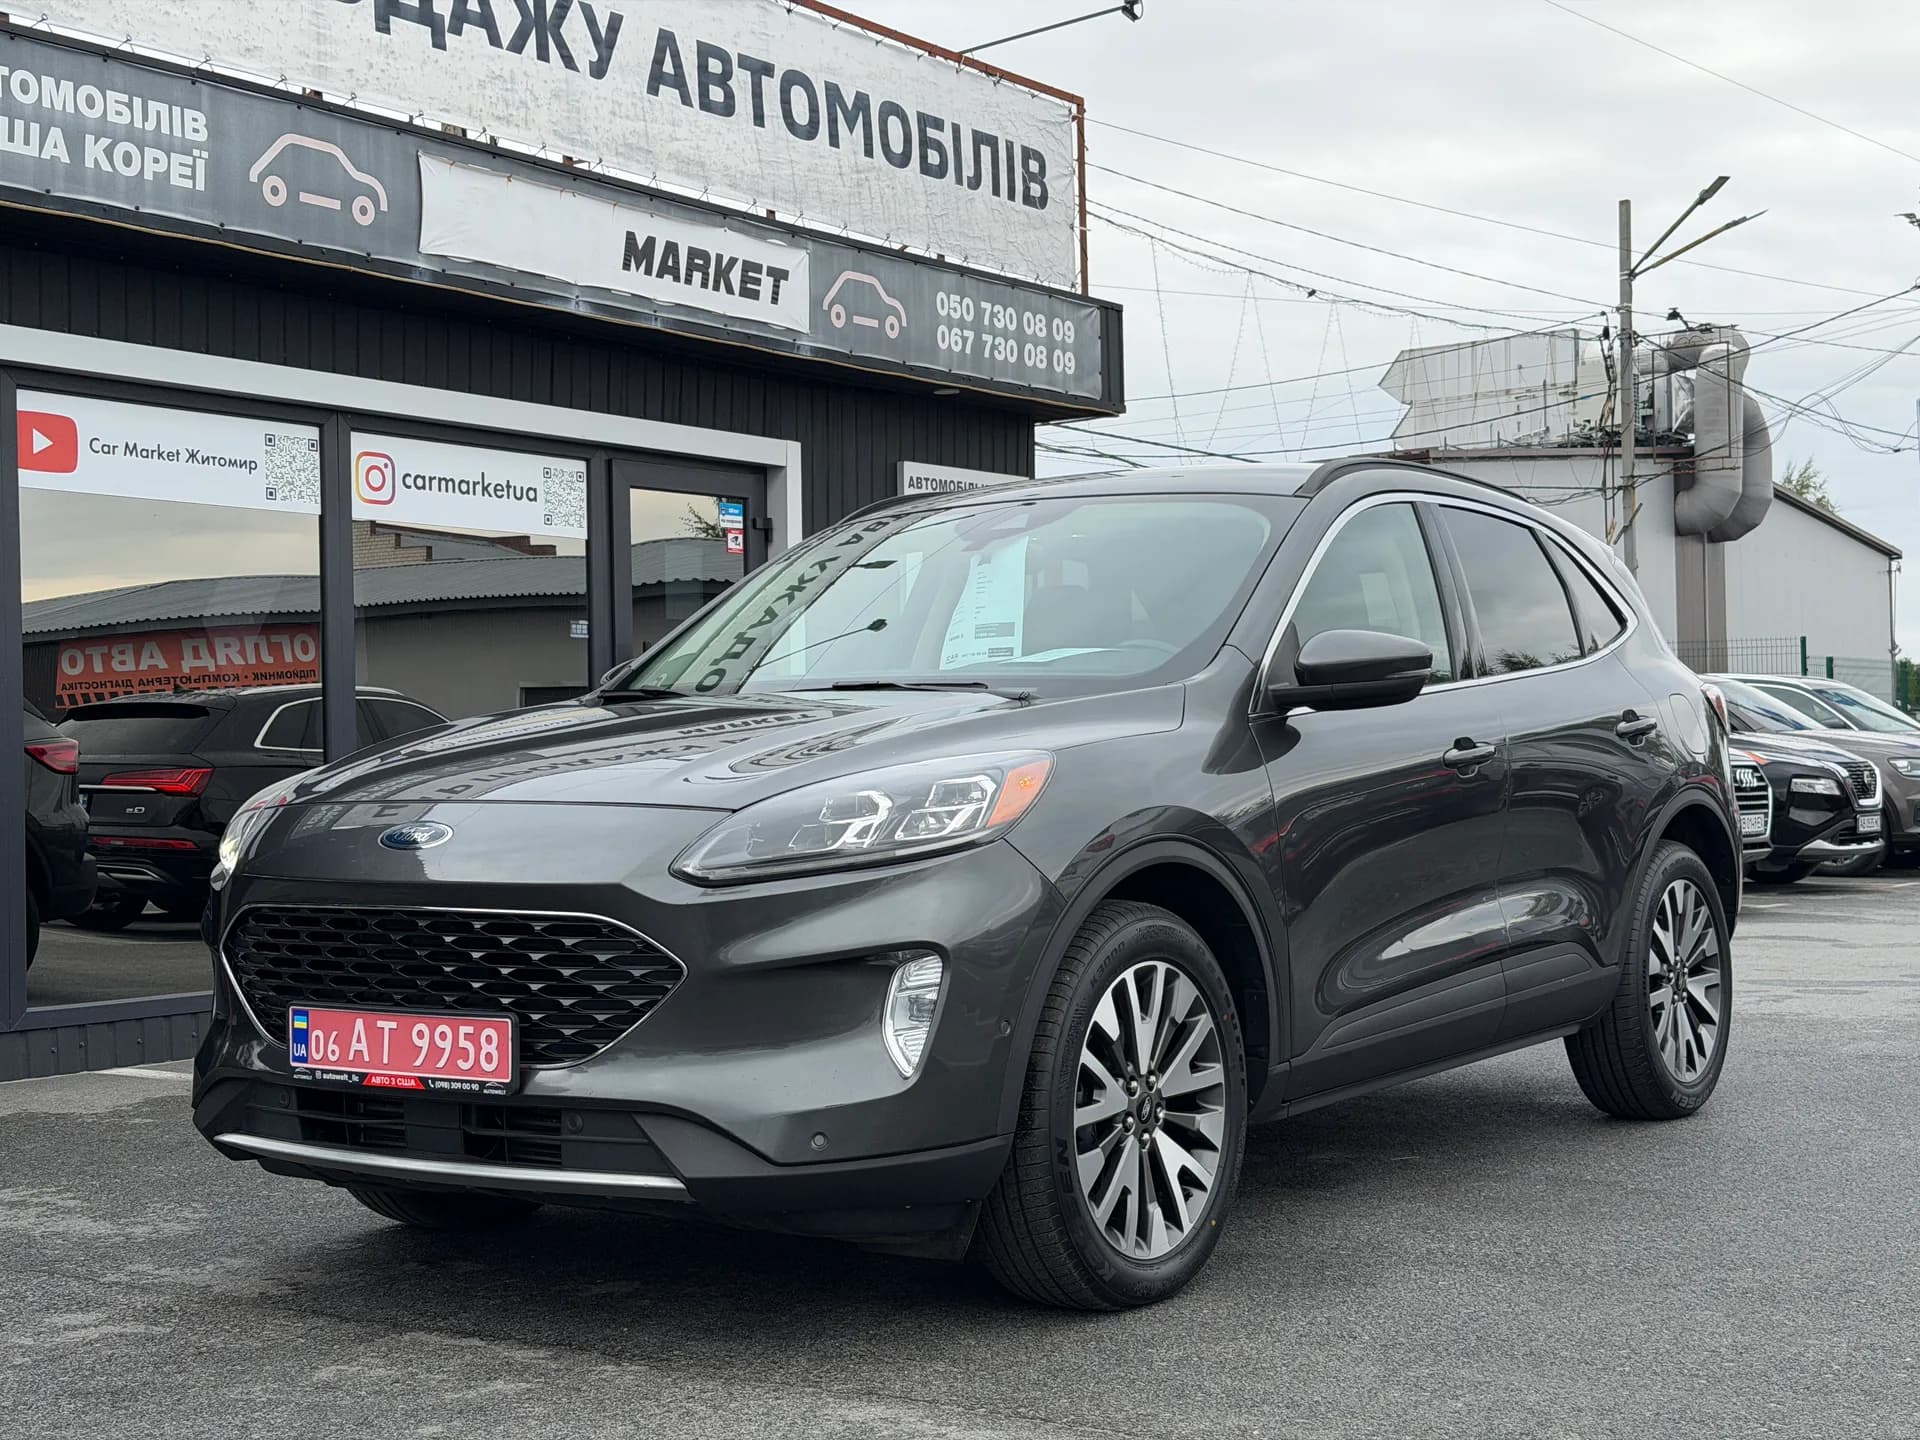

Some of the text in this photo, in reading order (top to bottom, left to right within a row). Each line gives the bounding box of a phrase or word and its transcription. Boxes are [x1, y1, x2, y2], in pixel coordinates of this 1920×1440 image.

[647, 27, 1049, 210] АВТОМОБІЛІВ
[84, 134, 209, 192] КОРЕЇ
[622, 230, 790, 305] MARKET
[936, 291, 1075, 344] 050 730 08 09
[937, 324, 1075, 375] 067 730 08 09
[89, 437, 258, 475] Car Market Житомир
[402, 471, 537, 502] carmarketua
[294, 1045, 307, 1057] UA
[311, 1018, 499, 1073] 06 AT 9958
